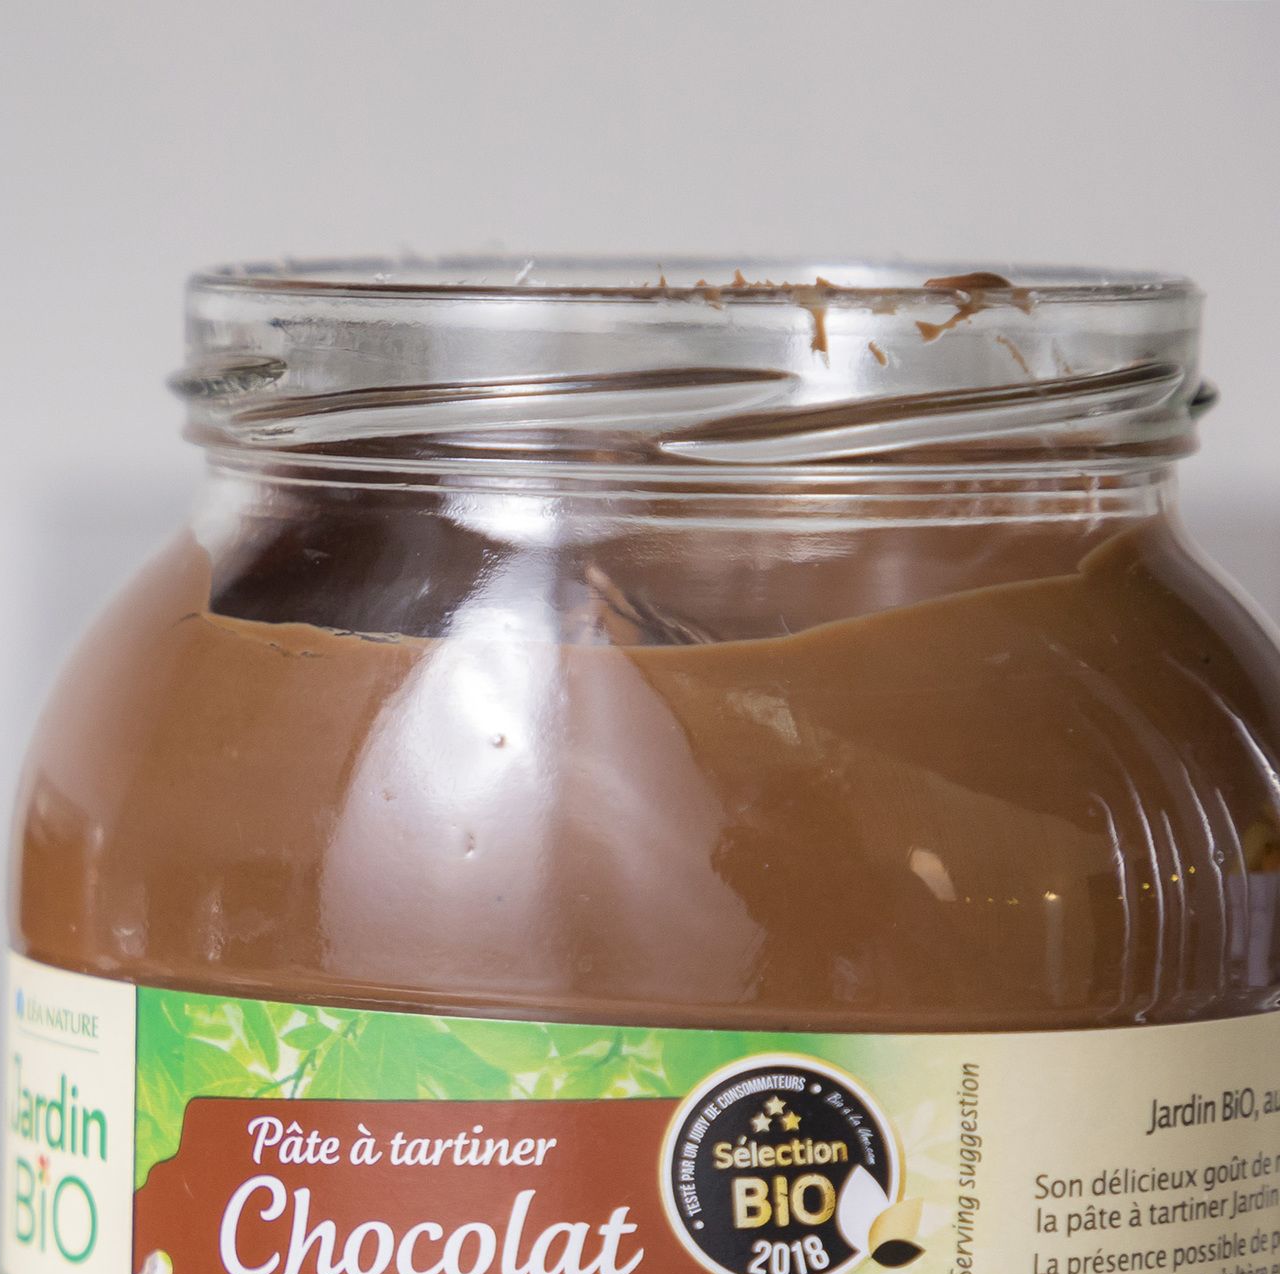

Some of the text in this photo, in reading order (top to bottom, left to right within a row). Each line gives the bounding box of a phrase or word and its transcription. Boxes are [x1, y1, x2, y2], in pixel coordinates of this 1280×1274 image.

[45, 1006, 100, 1039] NATURE
[11, 1053, 108, 1162] Jardin
[957, 1063, 983, 1190] suggestion
[1146, 1094, 1216, 1136] Jardin
[247, 1115, 557, 1166] Pâte à tartiner
[680, 1075, 807, 1217] TESTÉ PAR UN JURY DE CONSOMMATEURS
[712, 1136, 848, 1169] Sélection
[1034, 1174, 1083, 1200] Son
[1091, 1167, 1199, 1197] délicieux
[1203, 1155, 1248, 1191] goût
[1252, 1151, 1272, 1178] de
[732, 1174, 837, 1229] BIO
[1036, 1184, 1280, 1238] la pâte à tartiner Jardin
[1173, 1232, 1246, 1273] possible
[1250, 1228, 1268, 1254] de
